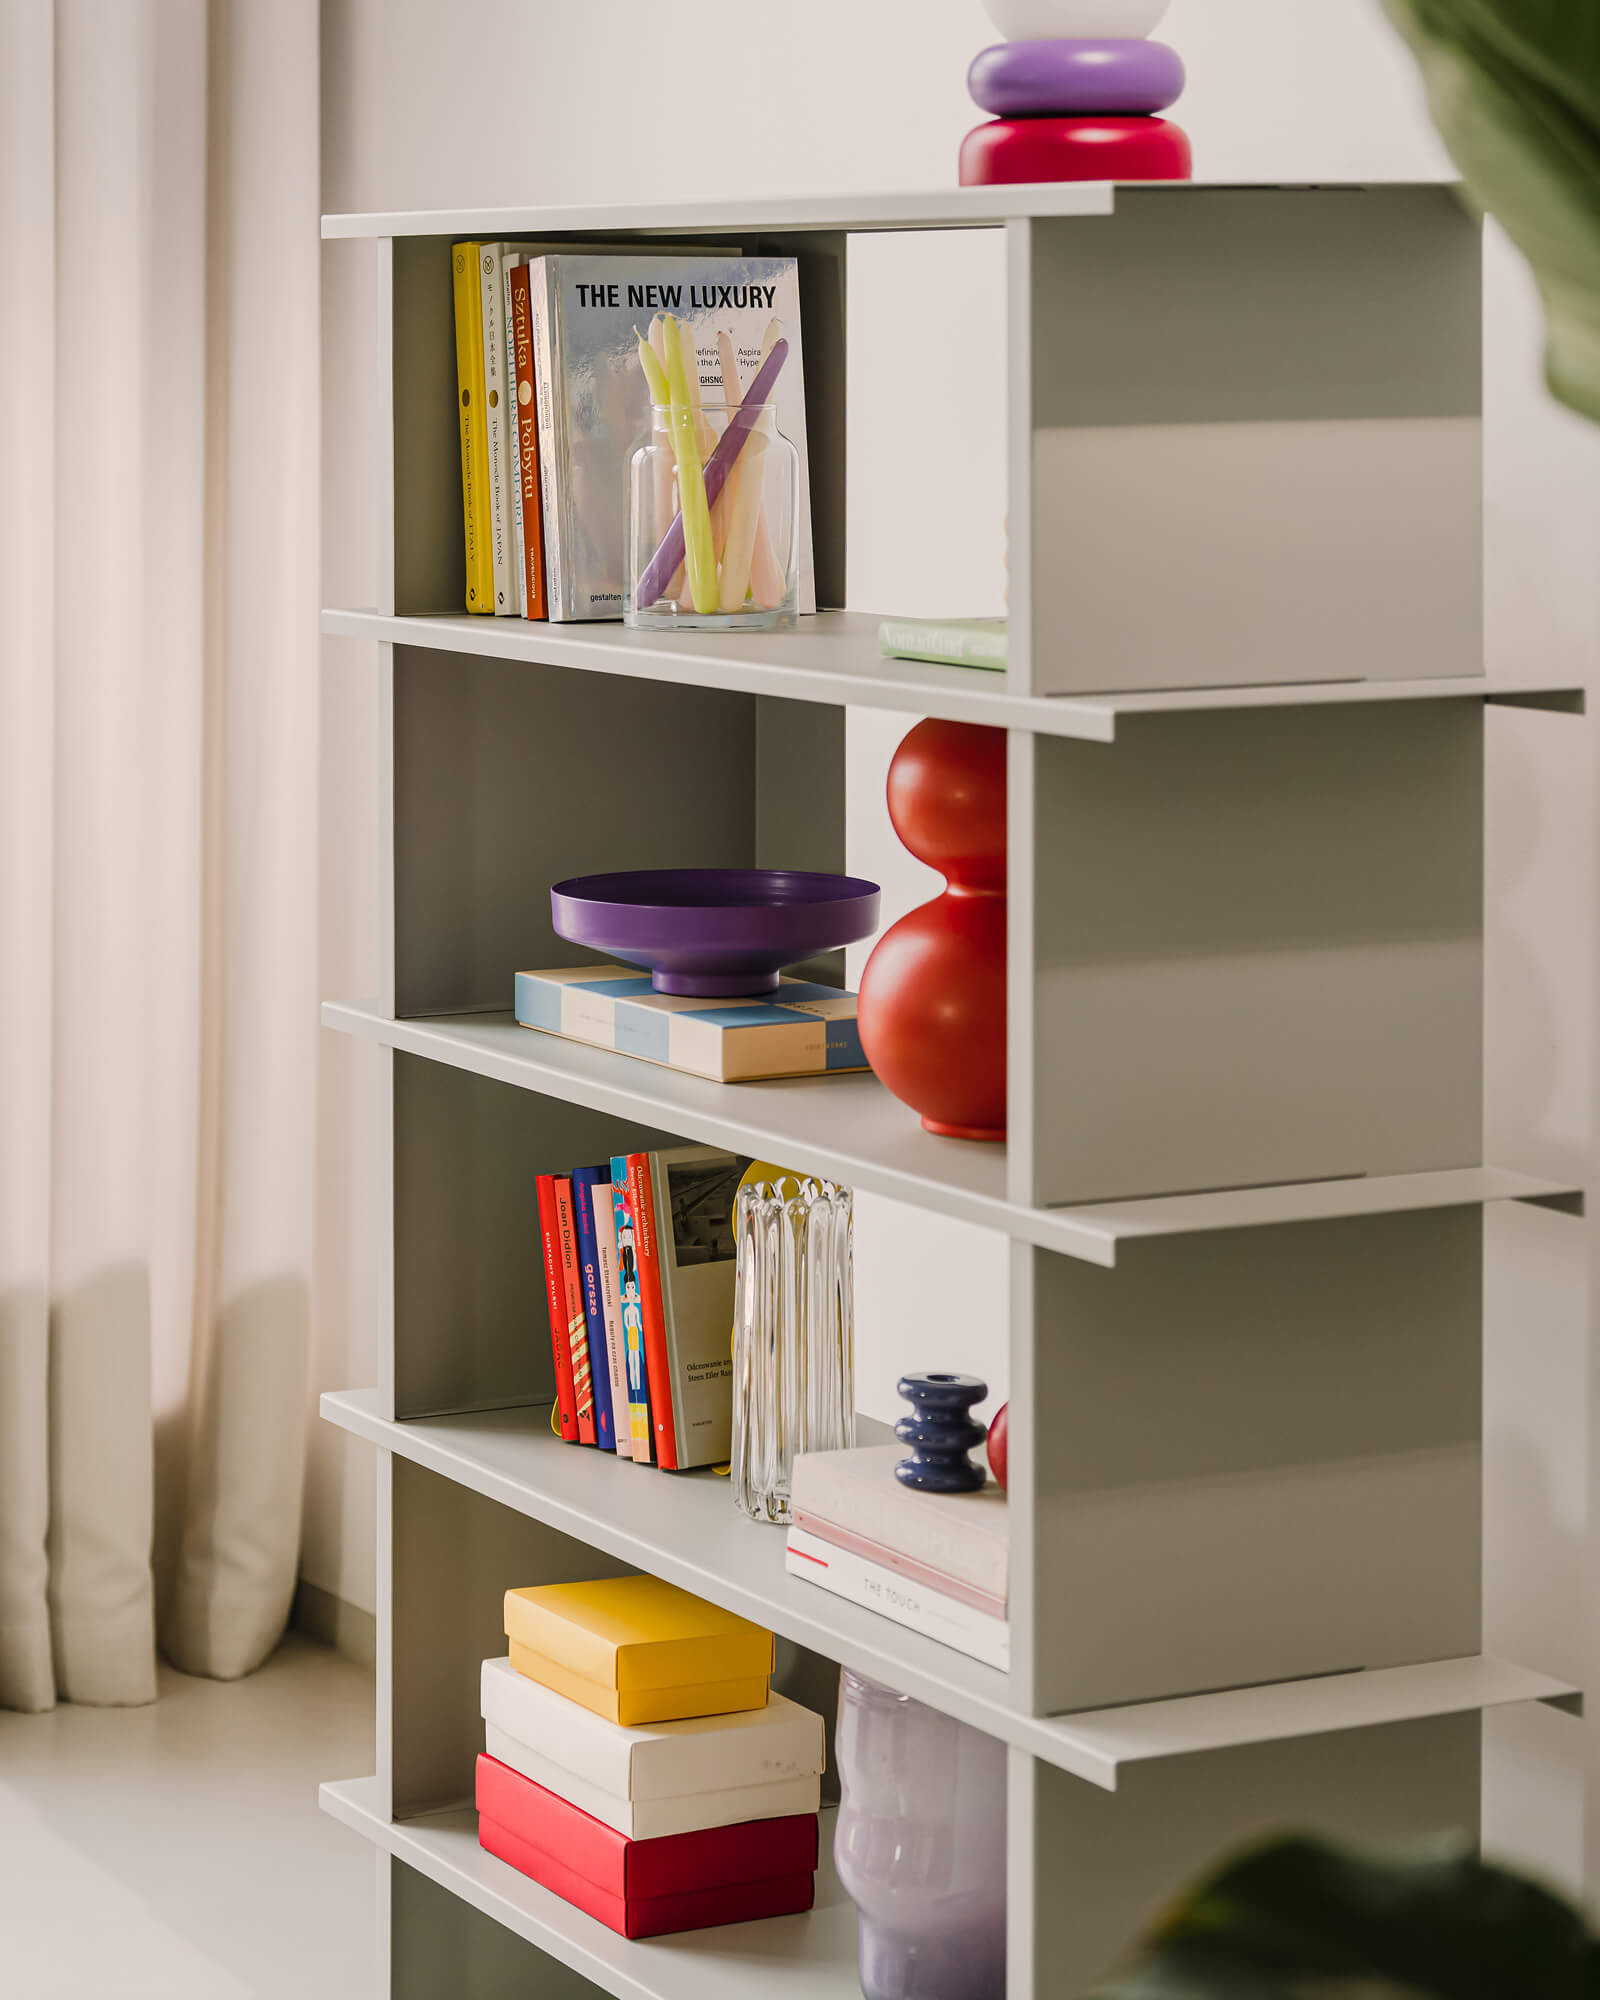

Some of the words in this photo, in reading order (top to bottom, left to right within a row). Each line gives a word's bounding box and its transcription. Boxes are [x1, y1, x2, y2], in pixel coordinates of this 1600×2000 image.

[576, 284, 620, 308] THE
[628, 284, 683, 308] NEW
[690, 284, 777, 308] LUXURY
[514, 287, 530, 369] Sztuka
[521, 417, 535, 499] Pobytu
[590, 592, 622, 603] gestalten
[559, 1197, 568, 1227] Joan
[562, 1229, 573, 1269] Didion
[584, 1263, 598, 1316] gorsze
[864, 1577, 881, 1598] THE
